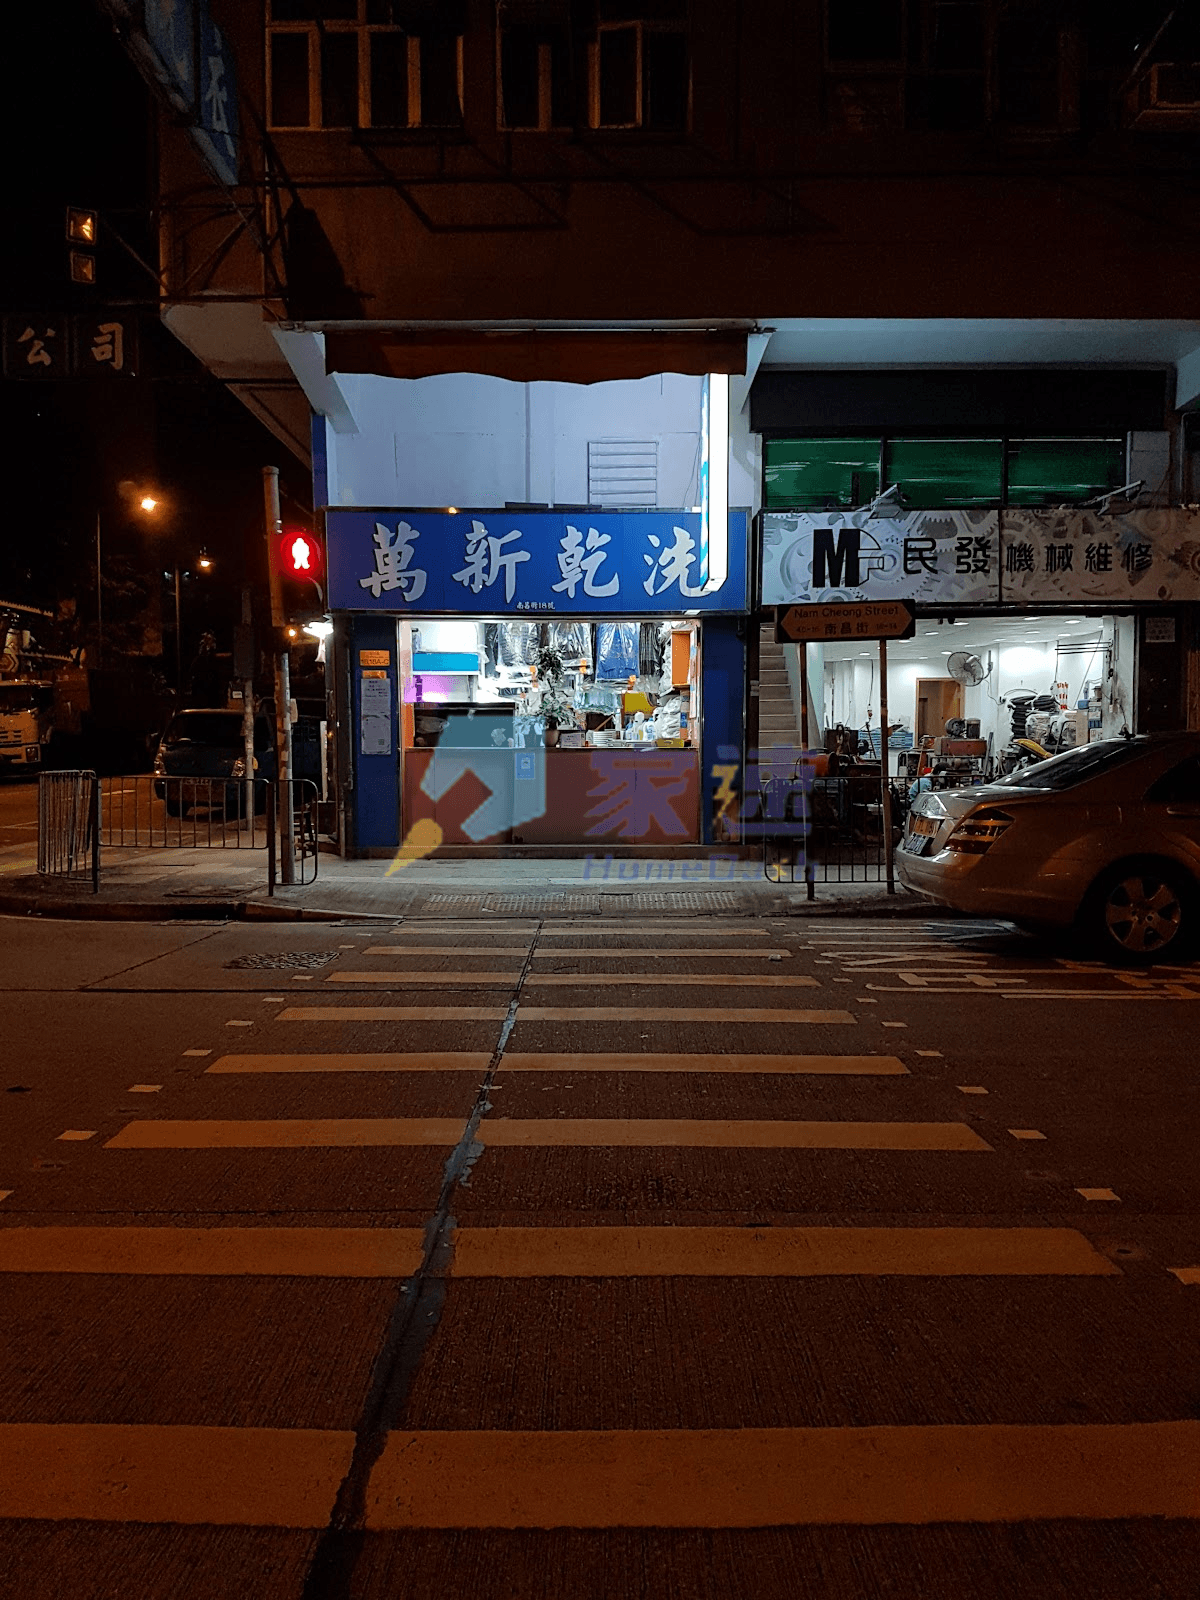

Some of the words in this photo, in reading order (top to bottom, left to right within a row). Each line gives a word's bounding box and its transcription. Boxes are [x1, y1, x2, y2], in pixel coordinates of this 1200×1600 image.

[17, 322, 123, 370] 公司
[360, 520, 714, 603] 萬新乾洗
[794, 608, 818, 618] Nam
[822, 607, 861, 618] Cheong
[865, 605, 898, 616] Street
[824, 622, 868, 635] 南昌街
